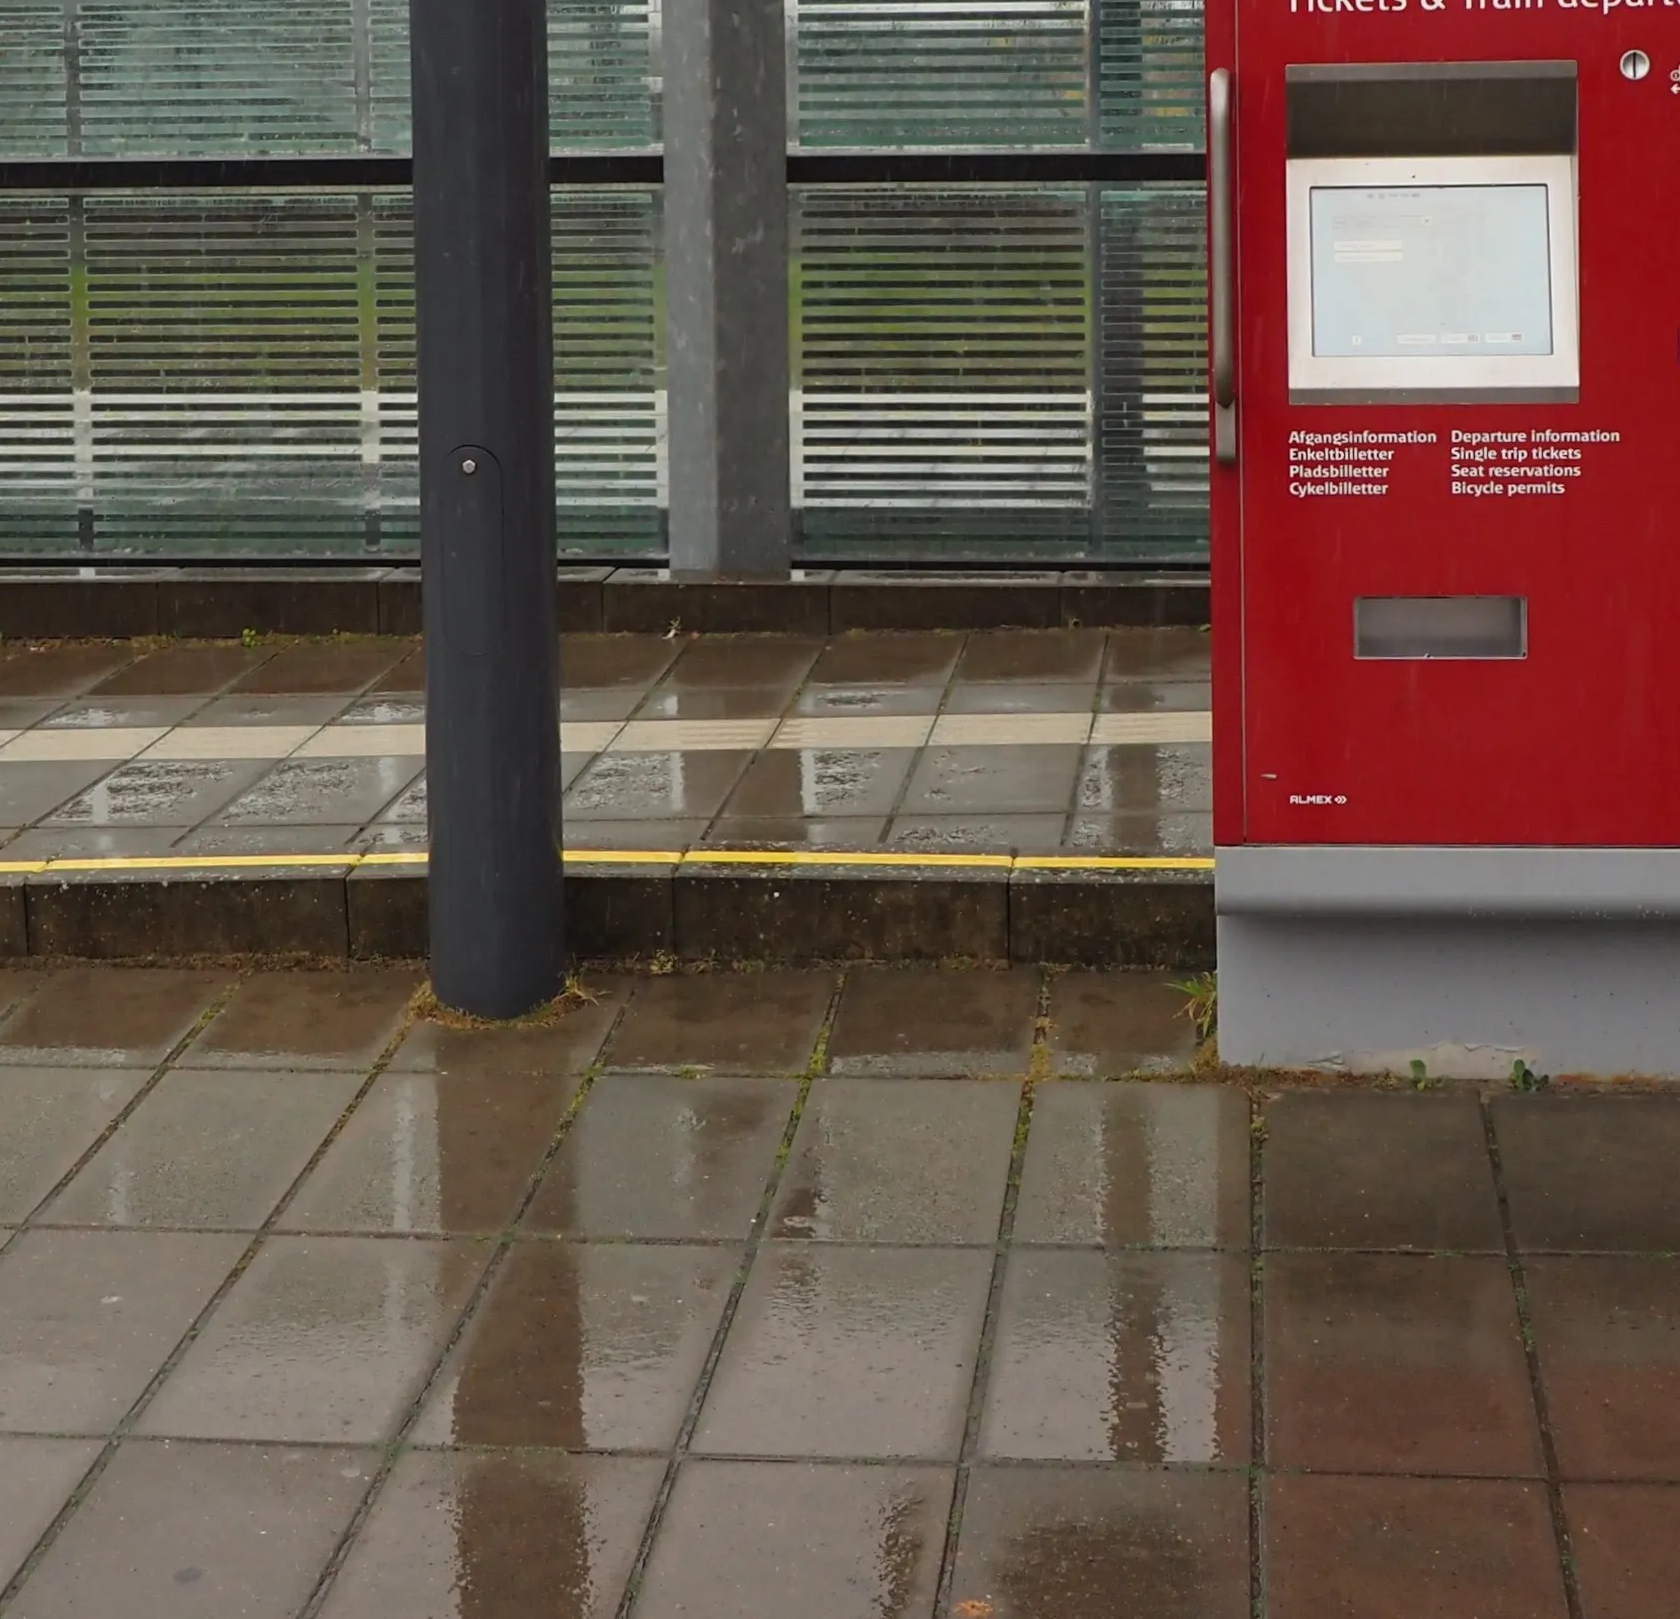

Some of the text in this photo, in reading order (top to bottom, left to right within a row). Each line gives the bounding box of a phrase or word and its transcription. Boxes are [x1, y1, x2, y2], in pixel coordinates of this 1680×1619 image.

[1289, 430, 1437, 446] Afgangsinformation
[1451, 429, 1620, 444] Departure information
[1289, 448, 1394, 462] Enkeltbilletter
[1451, 446, 1581, 462] Single trip tickets
[1289, 465, 1389, 478] Pladsbilletter
[1451, 463, 1581, 477] Seat reservations
[1289, 482, 1388, 498] Cykelbilletter
[1452, 481, 1565, 496] Bicycle permits
[1289, 795, 1332, 804] ALMEX
